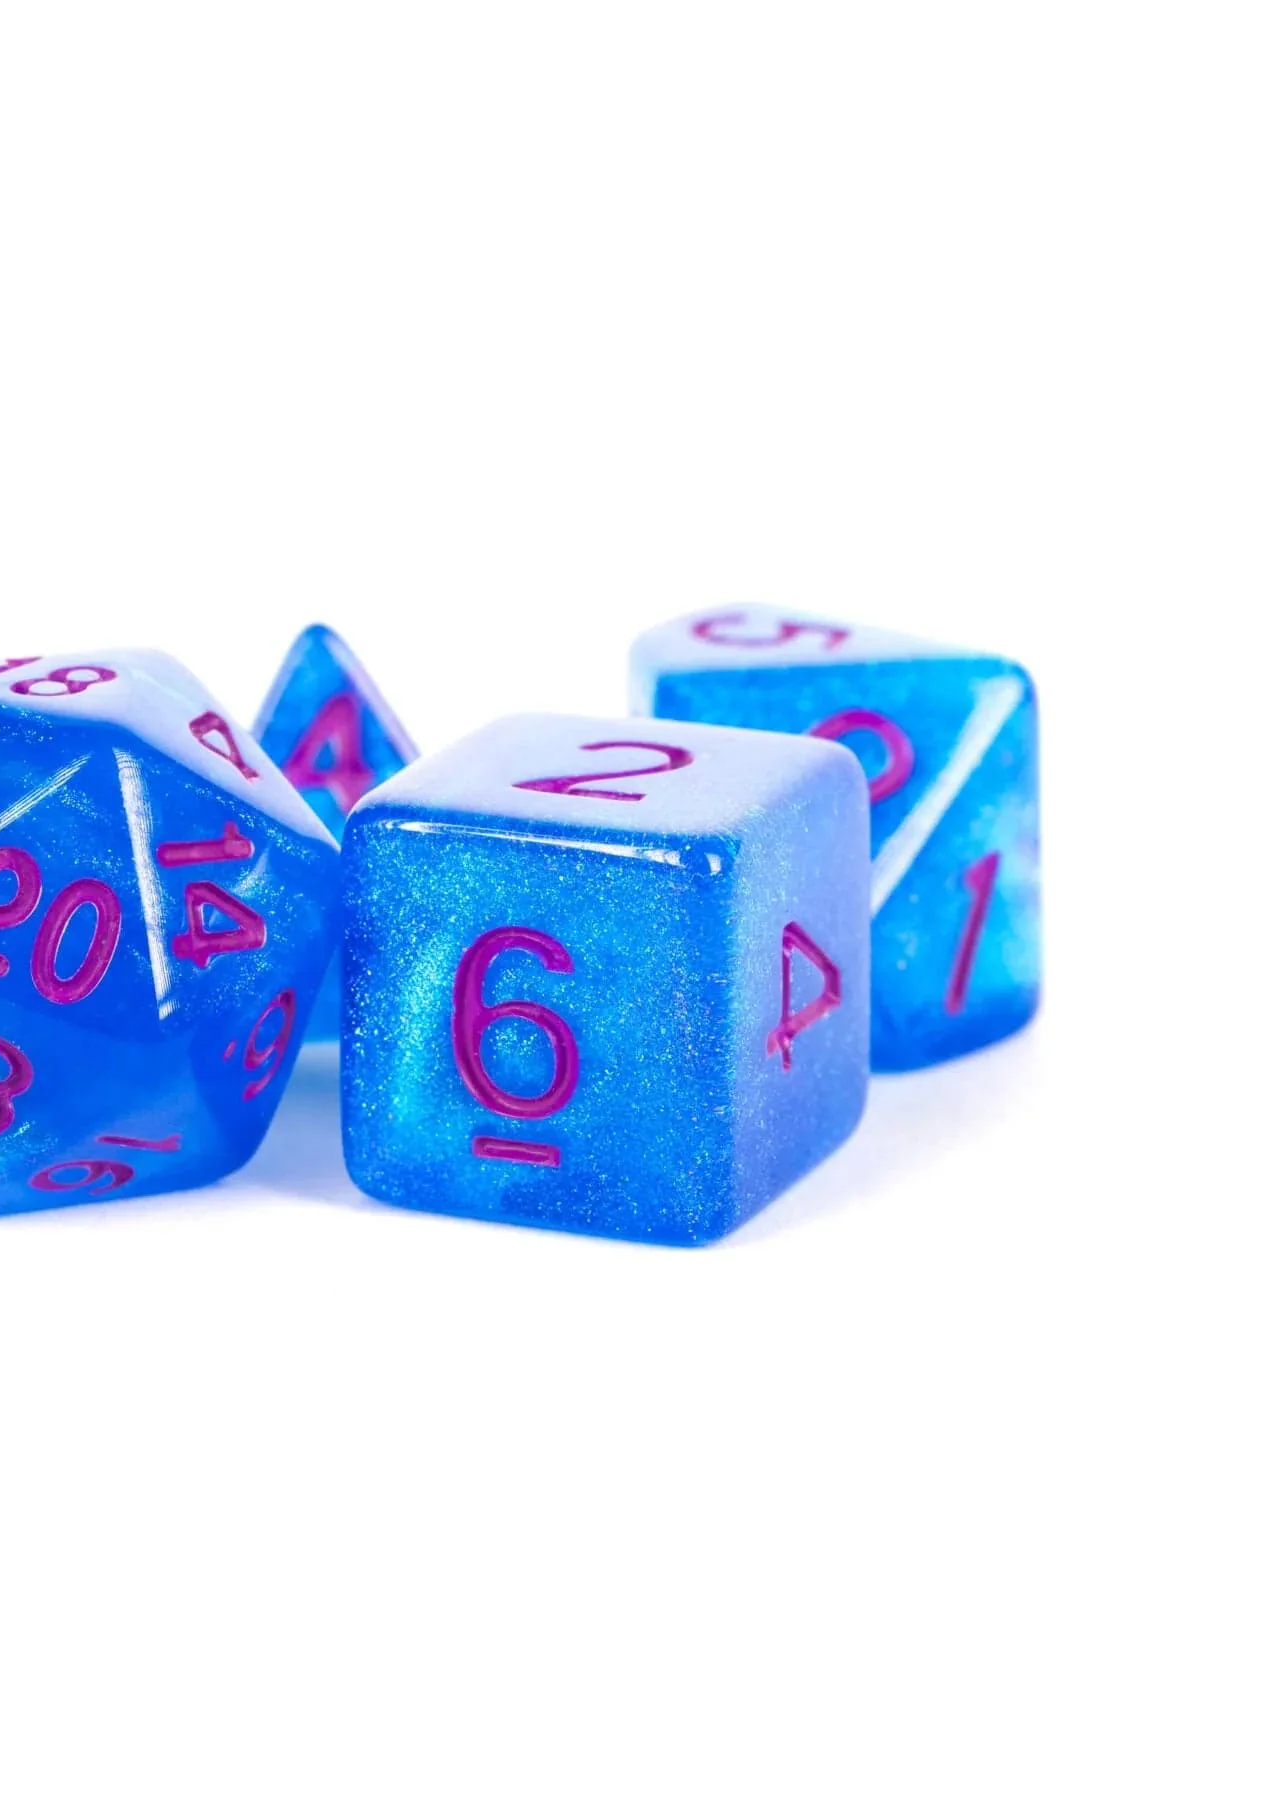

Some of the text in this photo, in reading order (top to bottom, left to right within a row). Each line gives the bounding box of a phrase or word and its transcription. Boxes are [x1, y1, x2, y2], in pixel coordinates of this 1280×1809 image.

[688, 612, 851, 651] 5
[282, 692, 375, 815] 4
[512, 740, 696, 802] 2
[155, 820, 267, 969] 14
[944, 851, 1000, 1014] 1
[765, 919, 843, 1073] 4
[28, 1134, 182, 1195] 16
